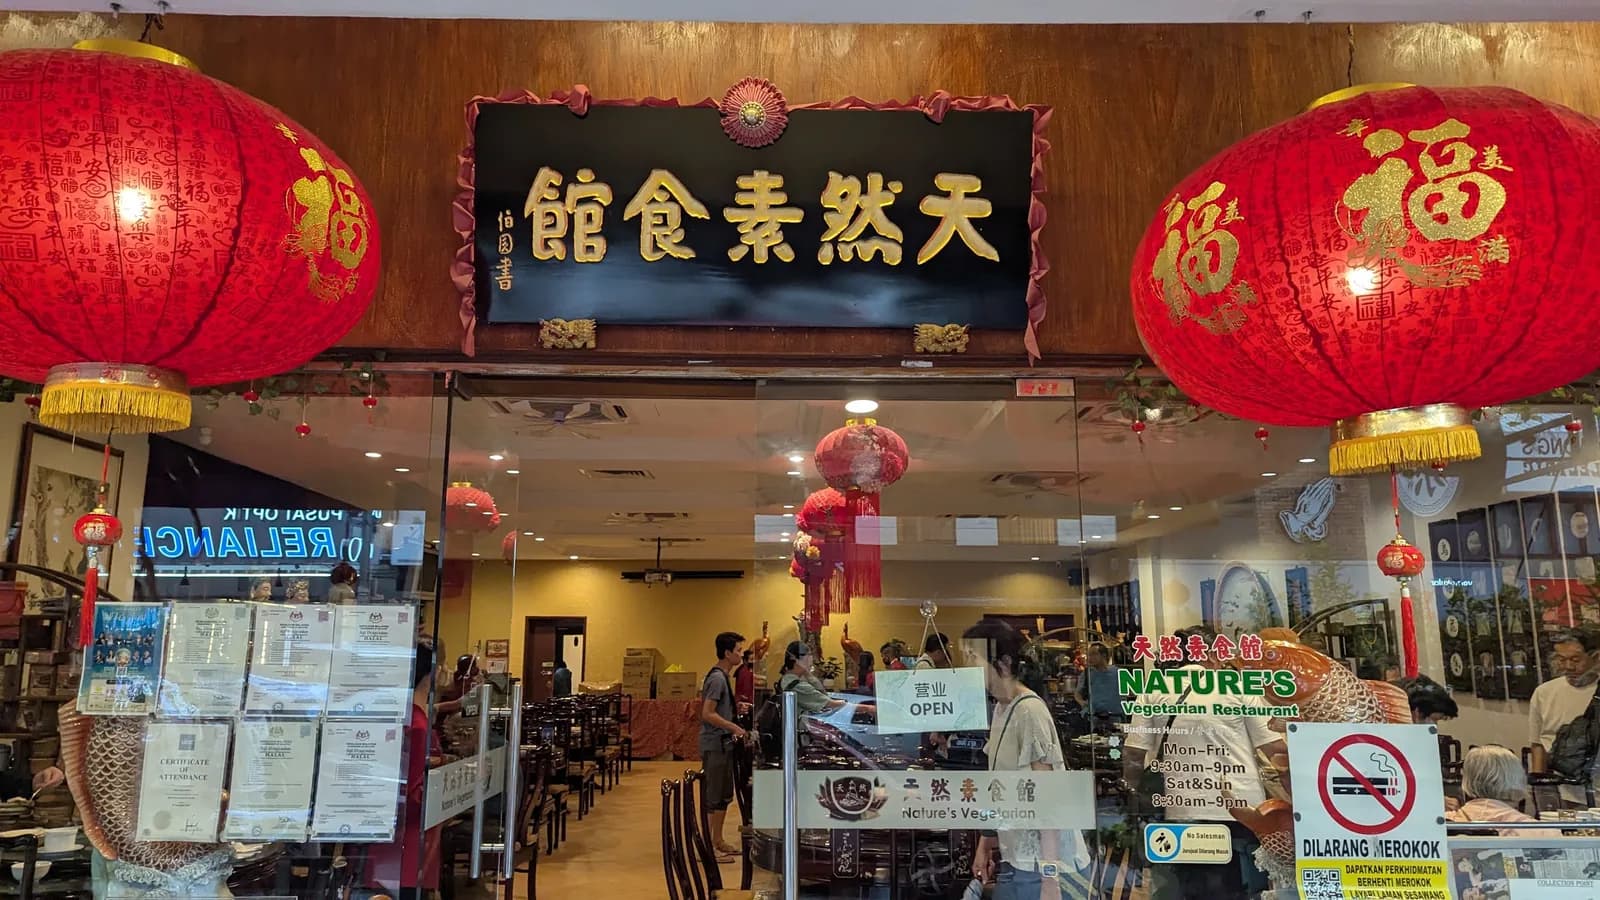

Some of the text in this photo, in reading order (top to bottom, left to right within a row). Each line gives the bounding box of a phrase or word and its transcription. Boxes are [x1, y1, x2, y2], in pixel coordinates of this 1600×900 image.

[1338, 118, 1507, 243] 福
[1153, 181, 1240, 300] 福
[1132, 635, 1263, 662] 天然素食館
[914, 681, 947, 698] 营业
[1118, 669, 1297, 696] NATURE'S
[910, 702, 954, 716] OPEN
[1122, 702, 1300, 718] Vegetarian Restaurant
[1123, 725, 1161, 735] Business
[1163, 726, 1189, 736] Hours
[903, 778, 1036, 803] 天然素食館
[1167, 778, 1233, 791] Sat&Sun
[902, 807, 1036, 821] Nature's Vegetarian
[1196, 832, 1226, 840] Salesman
[1303, 839, 1440, 859] DILARANG MEROKOK
[1346, 865, 1442, 875] DAPATKAN PERKHIDMATAN
[1357, 878, 1432, 887] BERHENTI MEROKOK
[1377, 891, 1402, 899] LAMAN
[1404, 891, 1446, 900] SESAWANG
